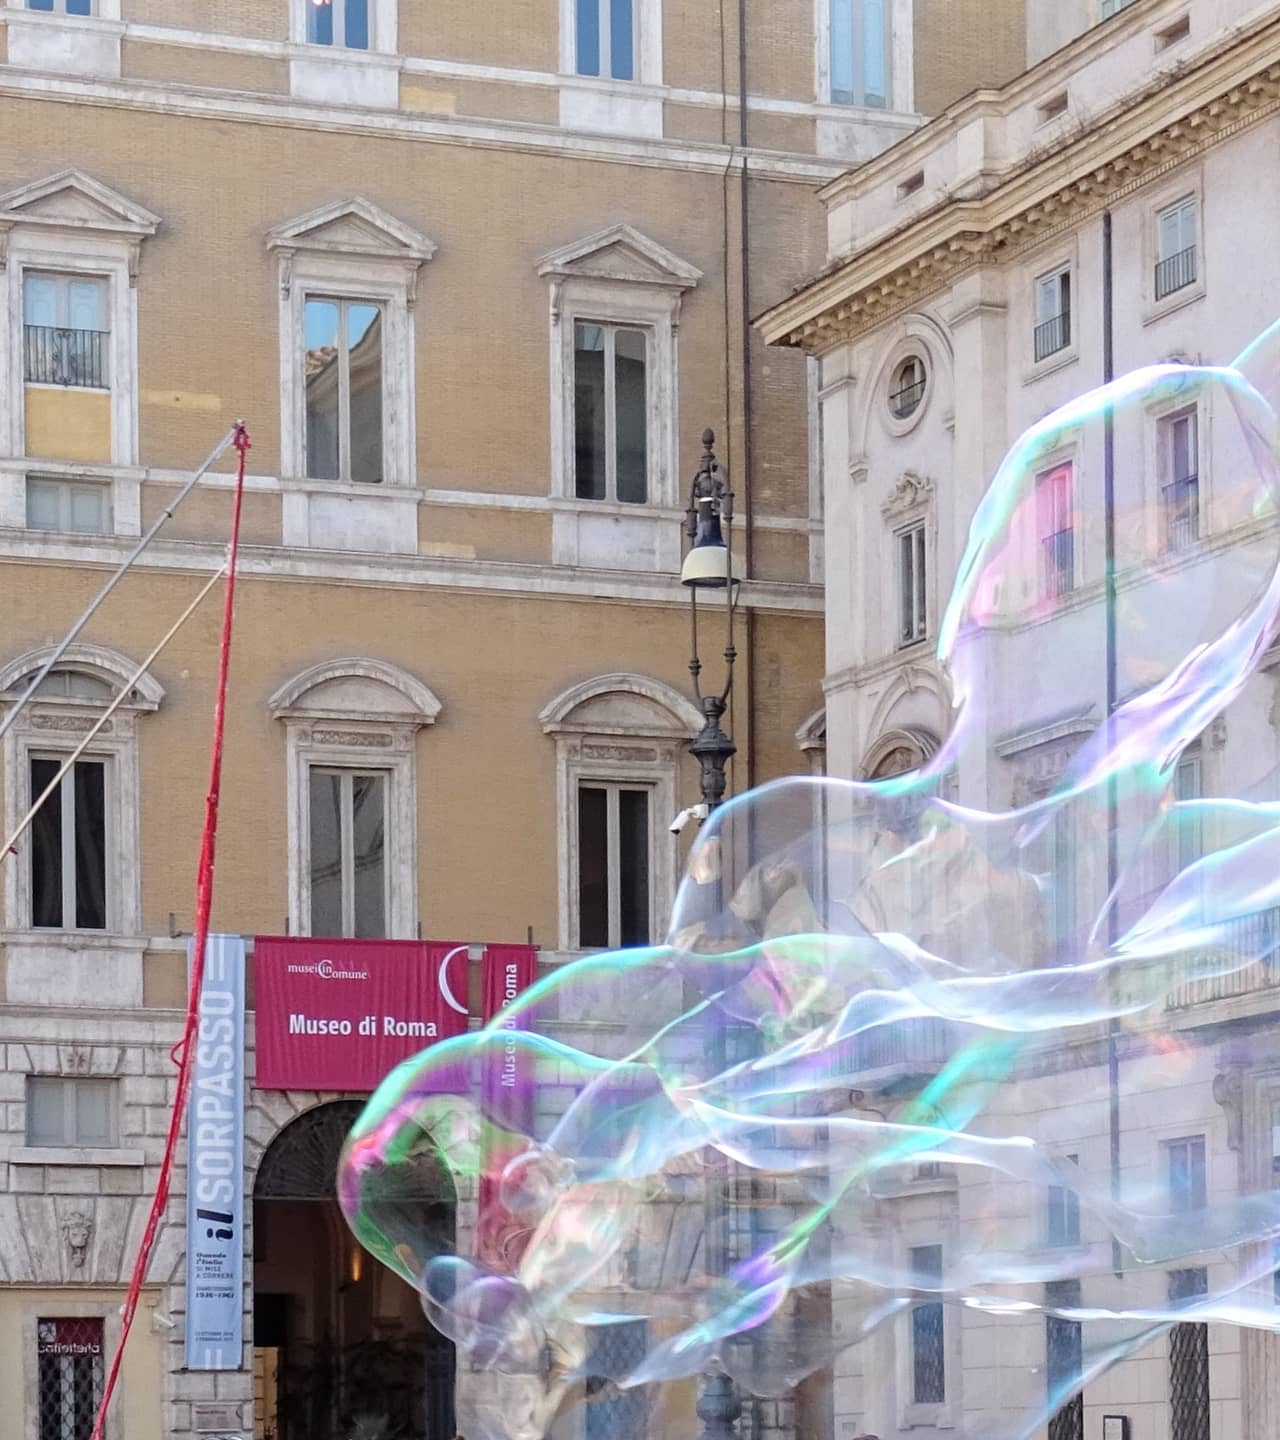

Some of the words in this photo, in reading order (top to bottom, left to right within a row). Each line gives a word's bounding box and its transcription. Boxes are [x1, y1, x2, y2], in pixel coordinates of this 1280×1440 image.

[289, 1014, 352, 1035] Museo
[358, 1016, 376, 1036] di
[383, 1017, 437, 1037] Roma
[196, 990, 235, 1202] SORPASSO
[196, 1208, 234, 1241] il
